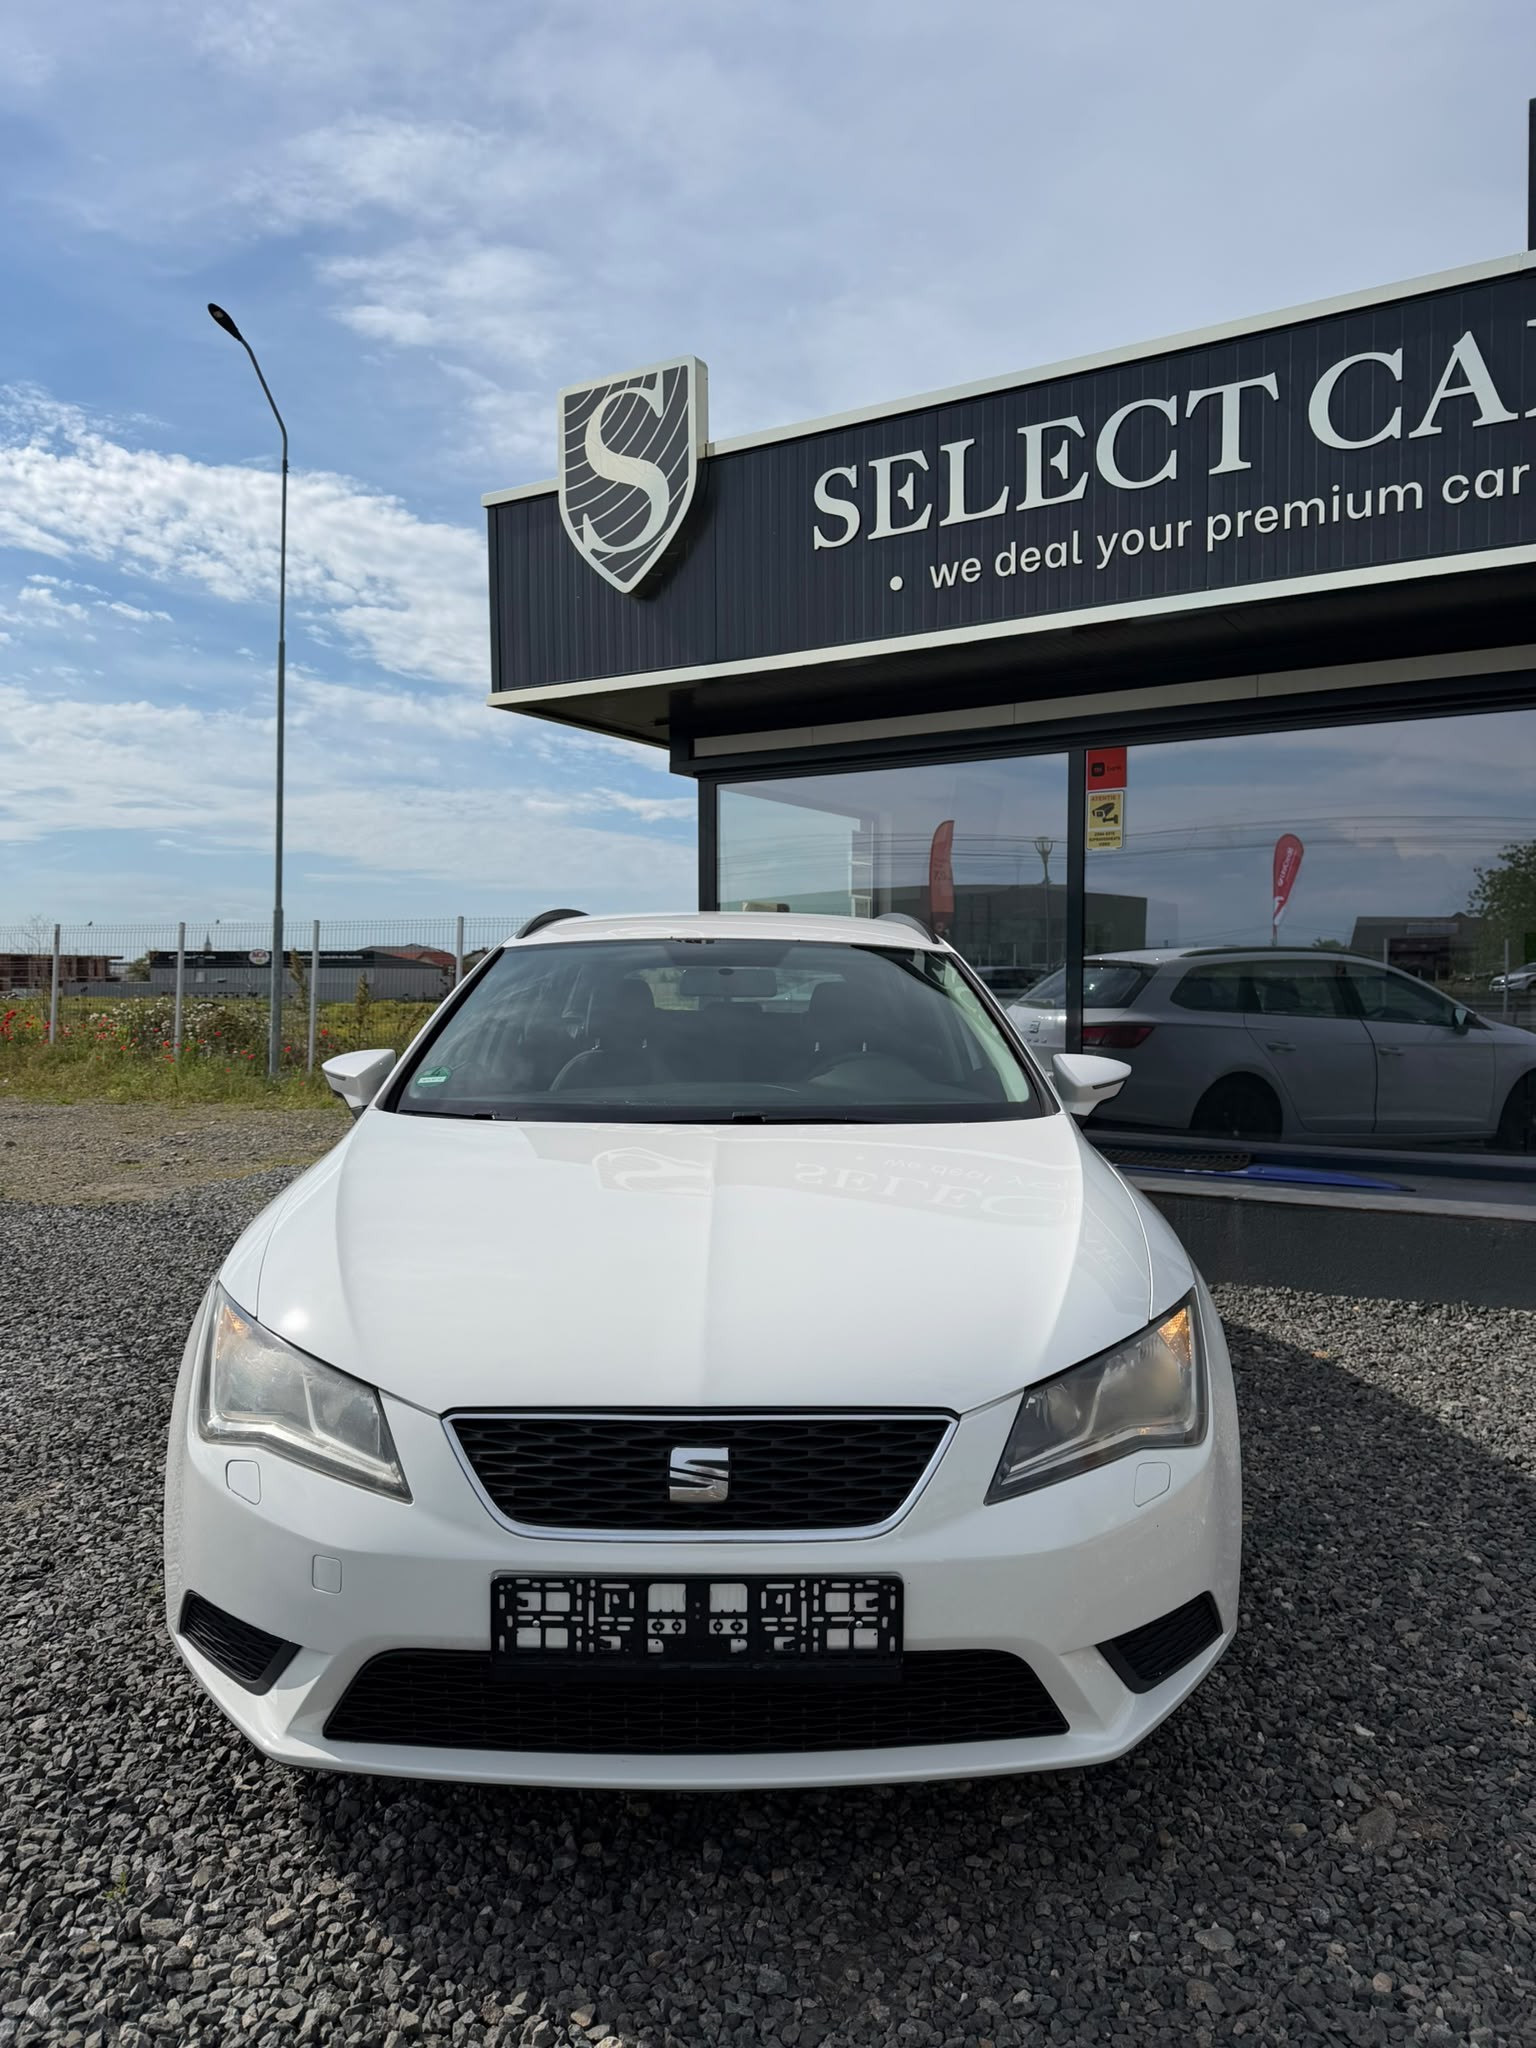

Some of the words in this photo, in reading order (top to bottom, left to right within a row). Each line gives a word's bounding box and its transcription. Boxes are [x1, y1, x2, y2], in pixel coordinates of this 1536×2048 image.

[583, 371, 670, 554] S
[813, 373, 1280, 550] SELECT
[1308, 318, 1536, 450] CA
[929, 557, 982, 589] we
[994, 530, 1083, 577] deal
[1096, 519, 1193, 570] your
[1207, 482, 1423, 553] premium
[1442, 464, 1530, 504] car
